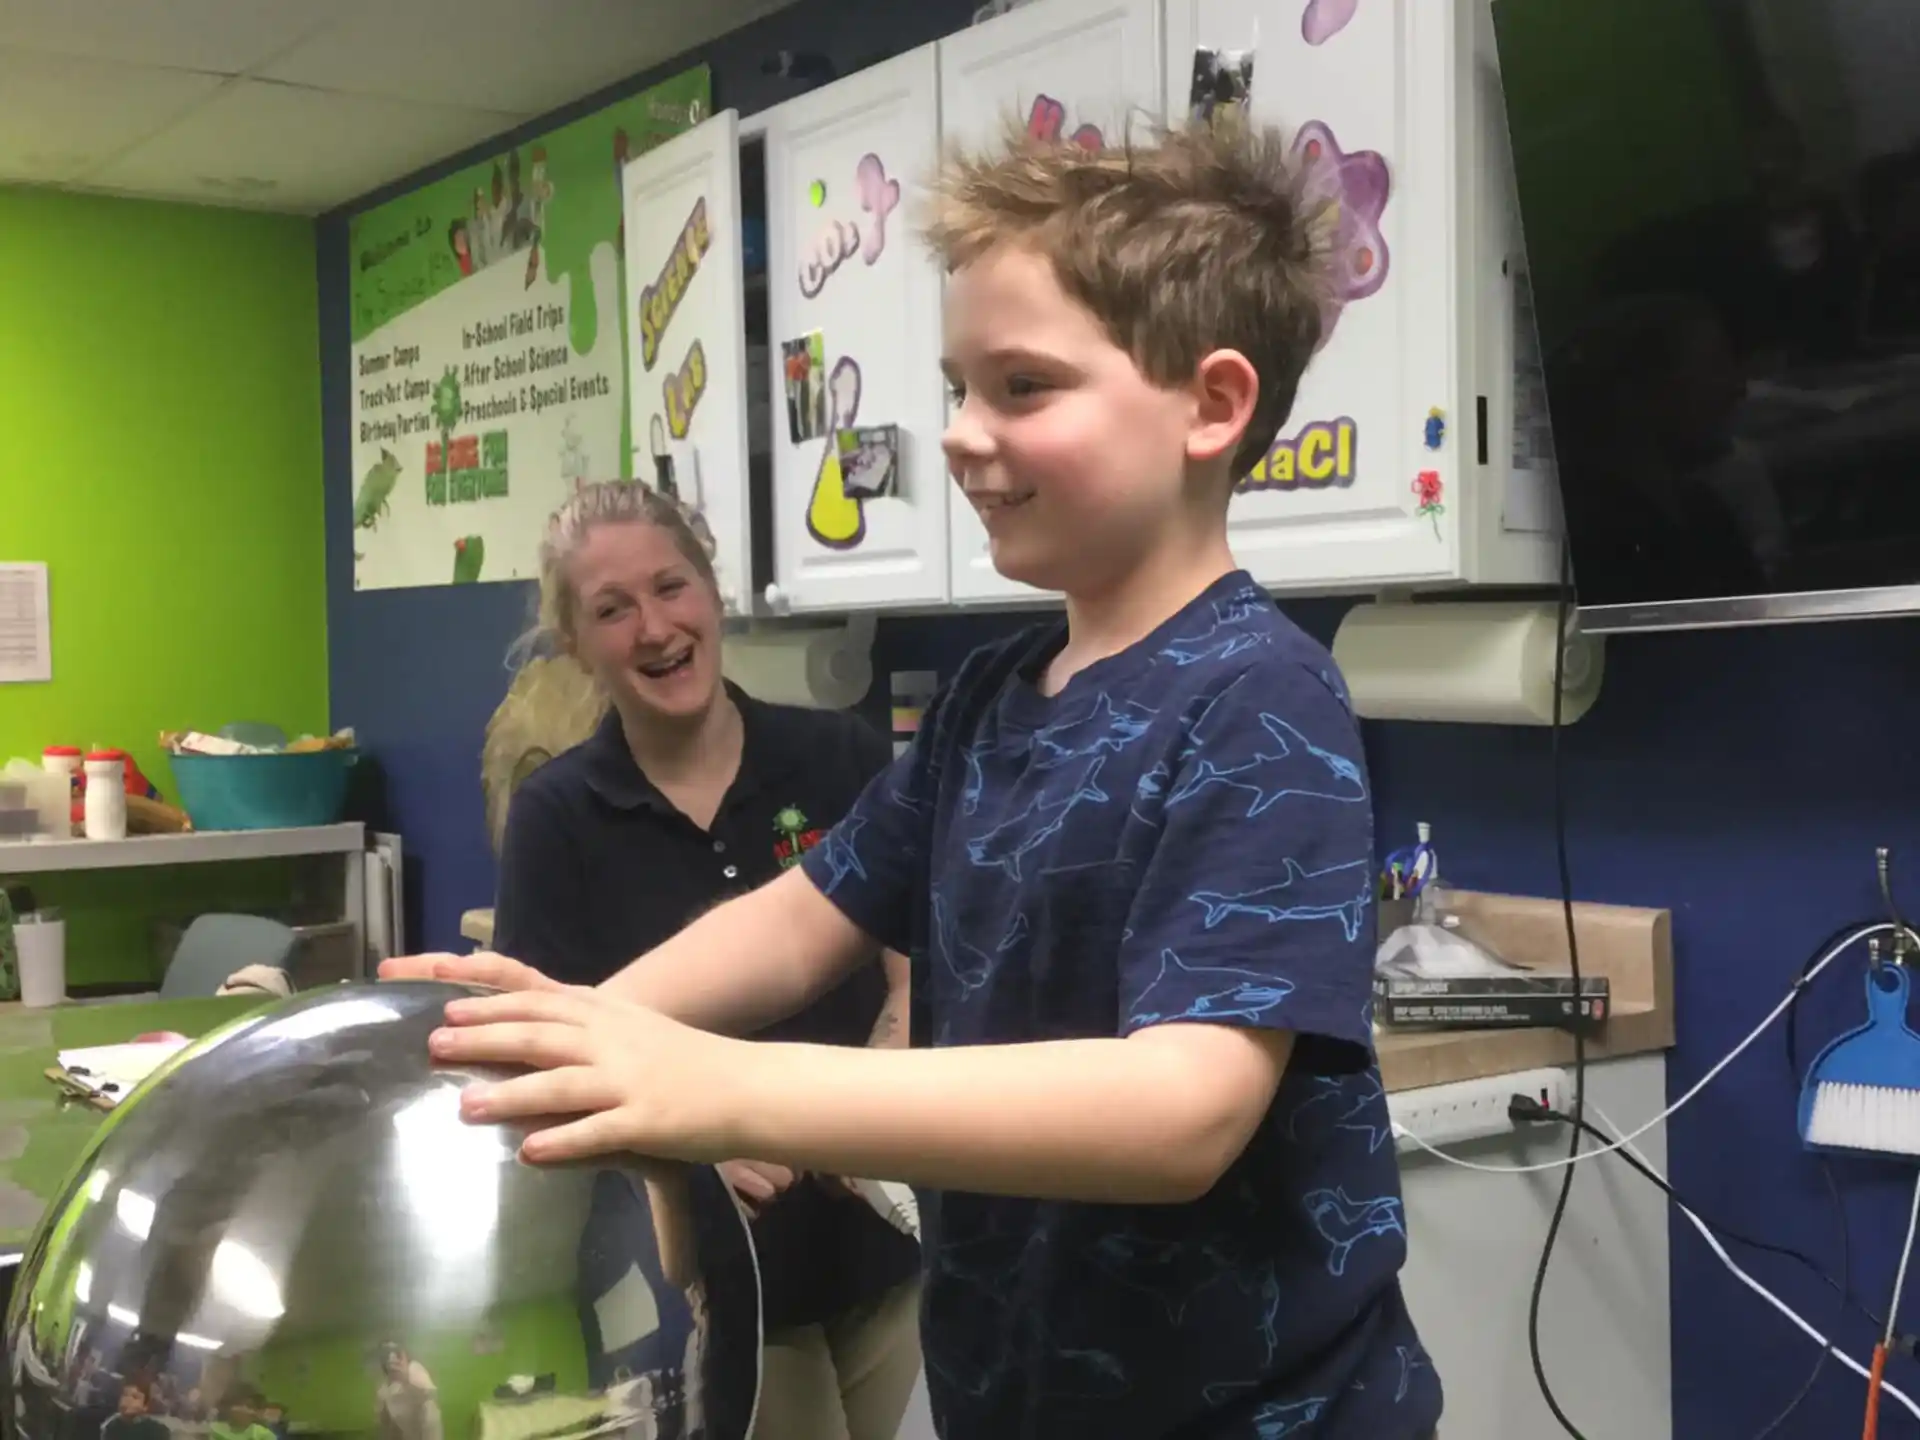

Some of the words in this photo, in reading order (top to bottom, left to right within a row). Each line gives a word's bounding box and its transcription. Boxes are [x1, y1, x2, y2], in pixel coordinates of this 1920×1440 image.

[462, 314, 507, 349] In-School
[510, 308, 533, 337] Field
[537, 303, 564, 332] Trips
[359, 353, 391, 376] Summer
[393, 345, 420, 369] Camps
[464, 361, 491, 386] After
[494, 349, 526, 380] School
[529, 344, 568, 373] Science
[360, 383, 401, 411] Track-Out
[404, 378, 430, 402] Camps
[464, 391, 517, 423] Preschools
[530, 377, 567, 415] Special
[570, 372, 609, 400] Events
[361, 420, 397, 444] Birthday
[398, 412, 430, 436] Parties
